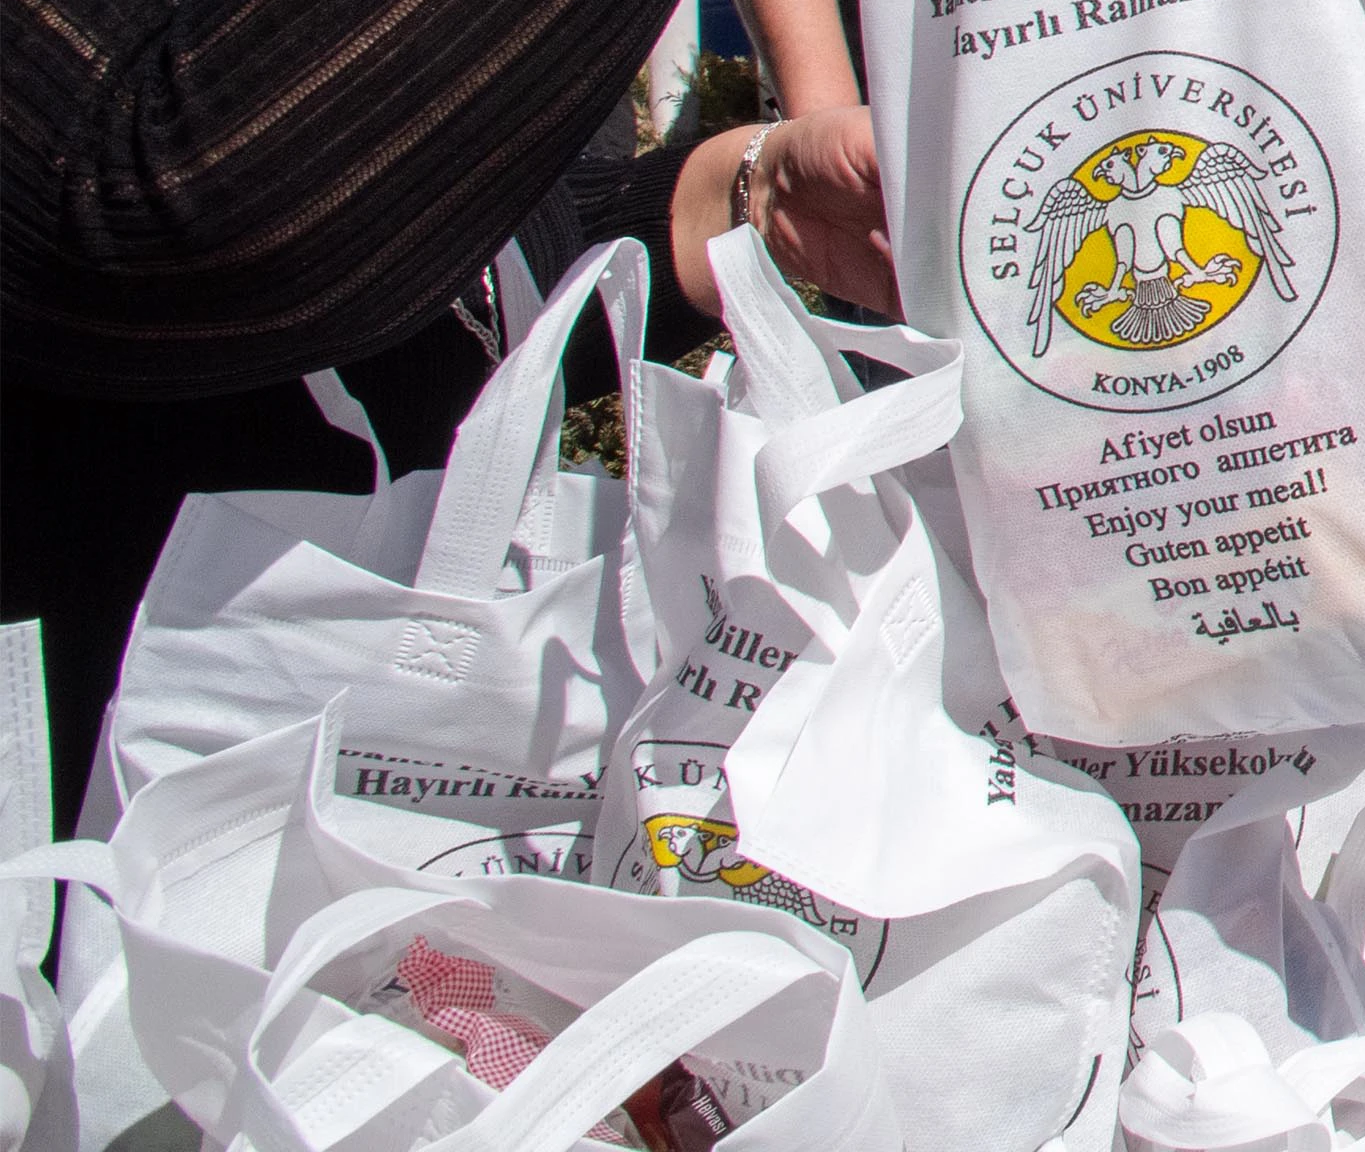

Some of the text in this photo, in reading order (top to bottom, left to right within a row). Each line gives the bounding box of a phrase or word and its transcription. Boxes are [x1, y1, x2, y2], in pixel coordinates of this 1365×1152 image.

[990, 72, 1317, 280] SELÇUK ÜNİVERSİTESİ
[1092, 345, 1245, 395] KONYA-1908
[1099, 411, 1277, 465] Afiyet olsun
[1036, 424, 1358, 511] Приятного аппетита
[1084, 467, 1329, 537] Enjoy your meal!
[1125, 516, 1312, 568] Guten appetit
[1148, 556, 1310, 601] Bon appétit
[1191, 601, 1300, 646] بالعافية
[352, 767, 497, 804] Hayırlı
[691, 1095, 728, 1135] Helvası
